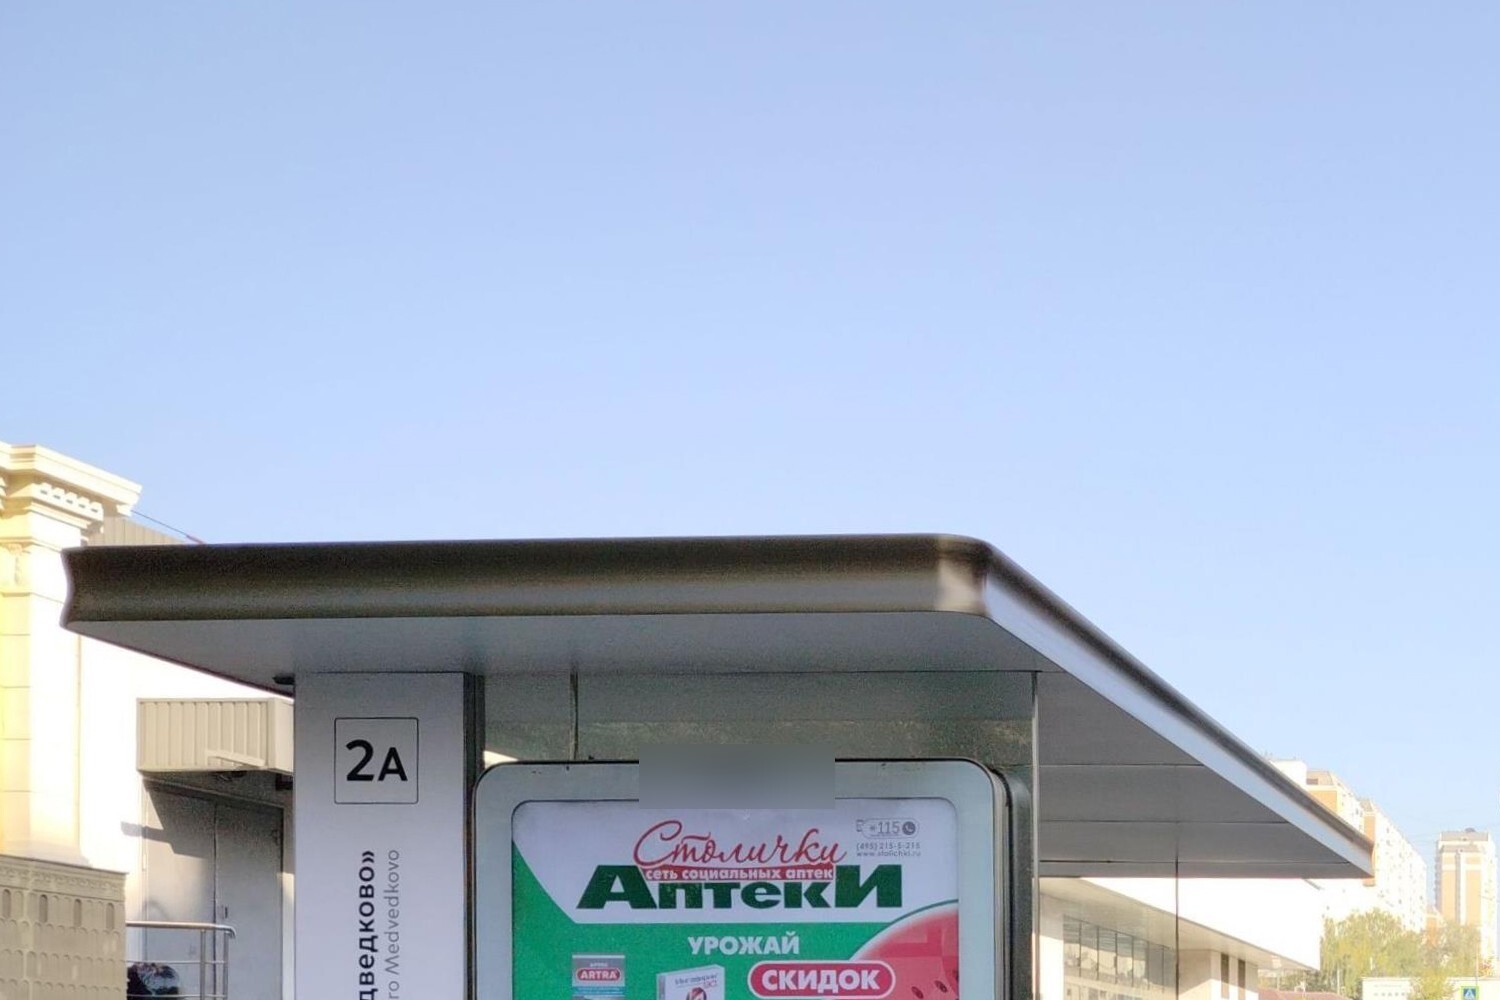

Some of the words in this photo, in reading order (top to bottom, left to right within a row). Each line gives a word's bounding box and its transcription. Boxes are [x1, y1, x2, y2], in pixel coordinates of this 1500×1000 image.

[345, 739, 409, 781] 2А
[633, 820, 847, 867] Столички
[646, 869, 679, 881] сеть
[682, 868, 781, 880] социальных
[785, 868, 834, 880] аптек
[383, 850, 400, 976] Medvedkovo
[687, 931, 800, 955] УРОЖАЙ
[762, 969, 881, 994] СКИДОК
